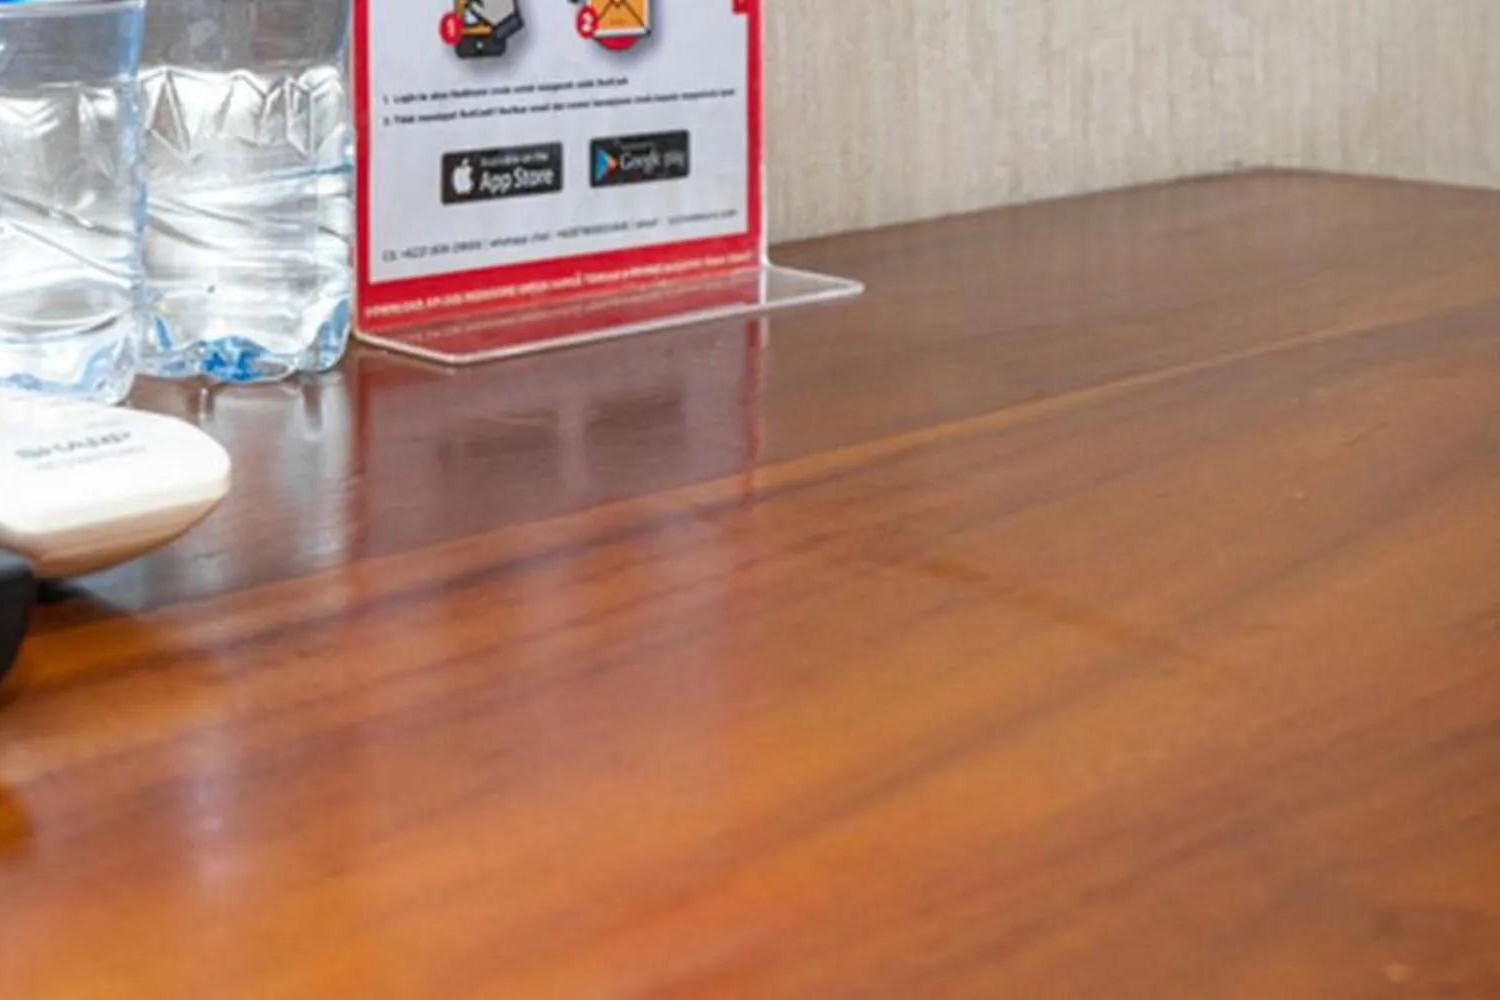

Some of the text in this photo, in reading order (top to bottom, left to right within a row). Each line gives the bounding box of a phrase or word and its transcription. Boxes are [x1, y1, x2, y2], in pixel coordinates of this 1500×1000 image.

[619, 150, 660, 175] Google
[479, 166, 554, 194] App Store
